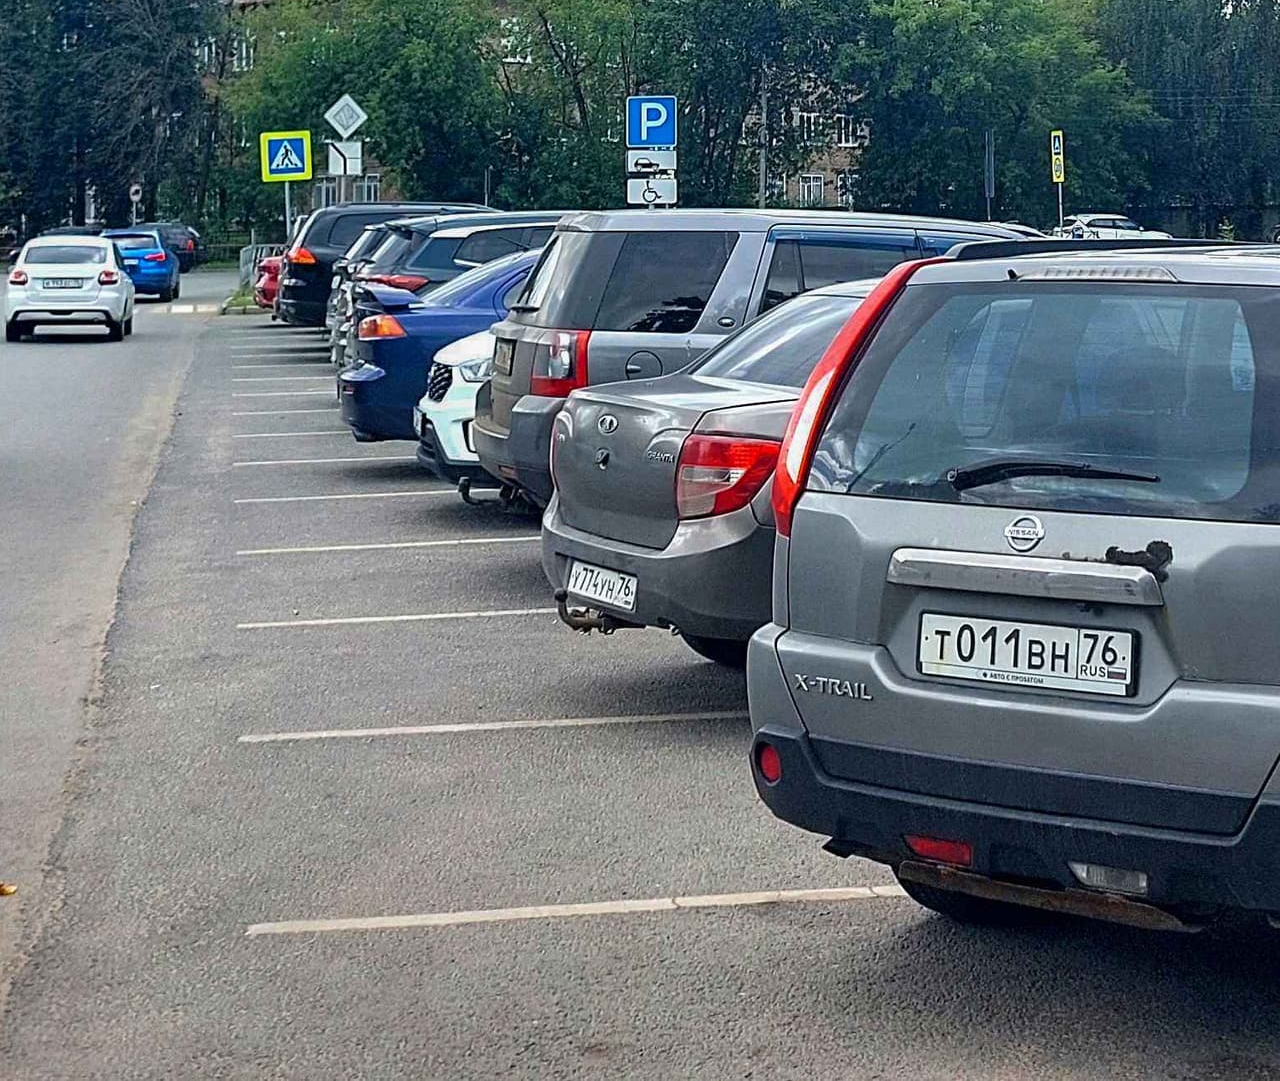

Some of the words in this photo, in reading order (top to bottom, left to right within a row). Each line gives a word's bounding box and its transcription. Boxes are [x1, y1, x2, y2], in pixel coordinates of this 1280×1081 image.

[641, 102, 668, 141] P
[617, 576, 632, 598] 76
[1083, 633, 1118, 666] 76
[1079, 665, 1106, 678] RUS
[794, 673, 874, 701] X-TRAIL
